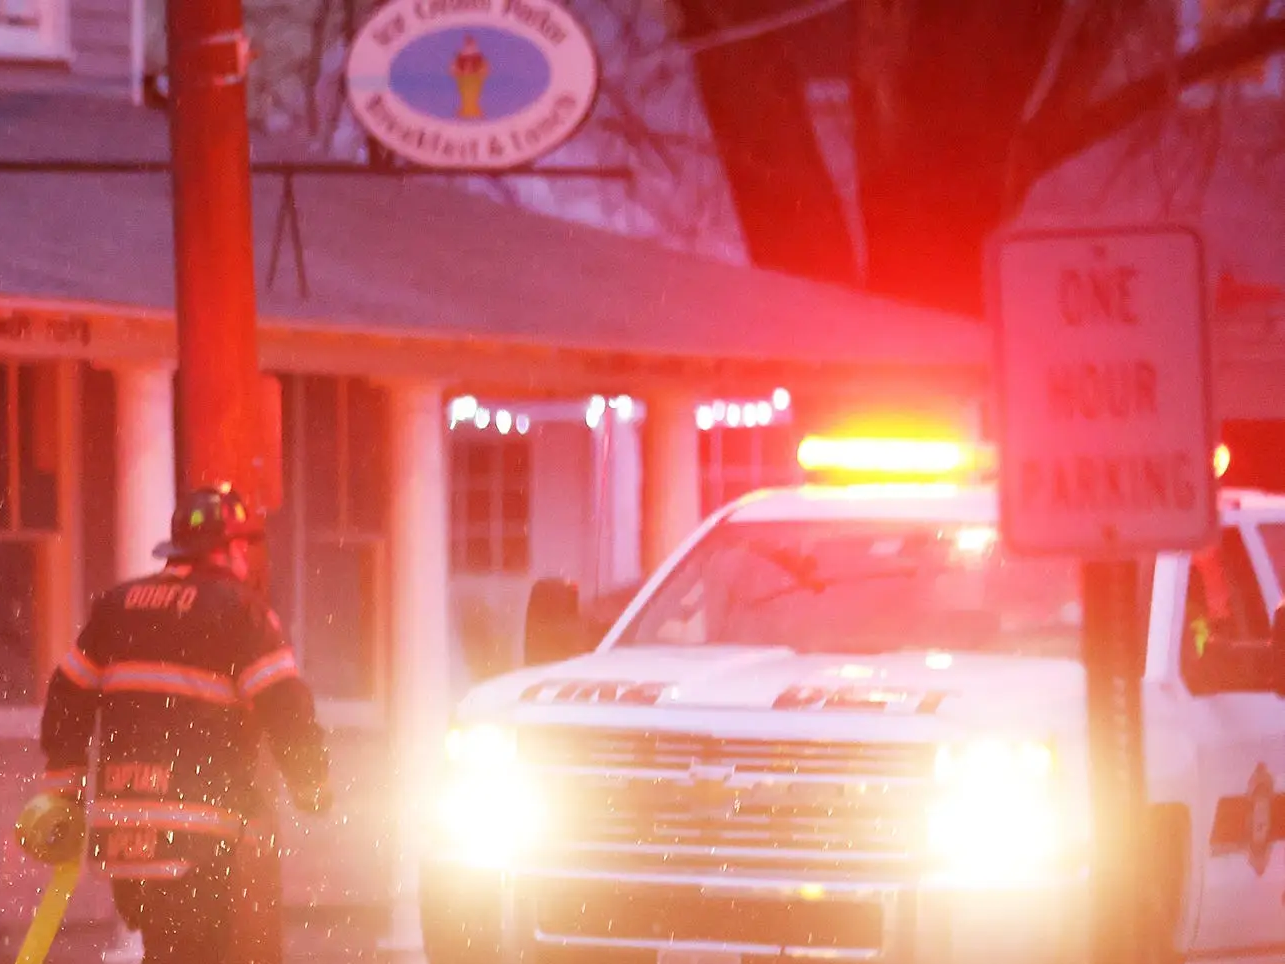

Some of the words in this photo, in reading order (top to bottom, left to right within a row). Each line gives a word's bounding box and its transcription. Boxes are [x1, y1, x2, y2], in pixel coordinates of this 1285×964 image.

[1059, 266, 1139, 327] ONE
[1047, 360, 1158, 420] HOUR
[1020, 453, 1197, 511] PARKING
